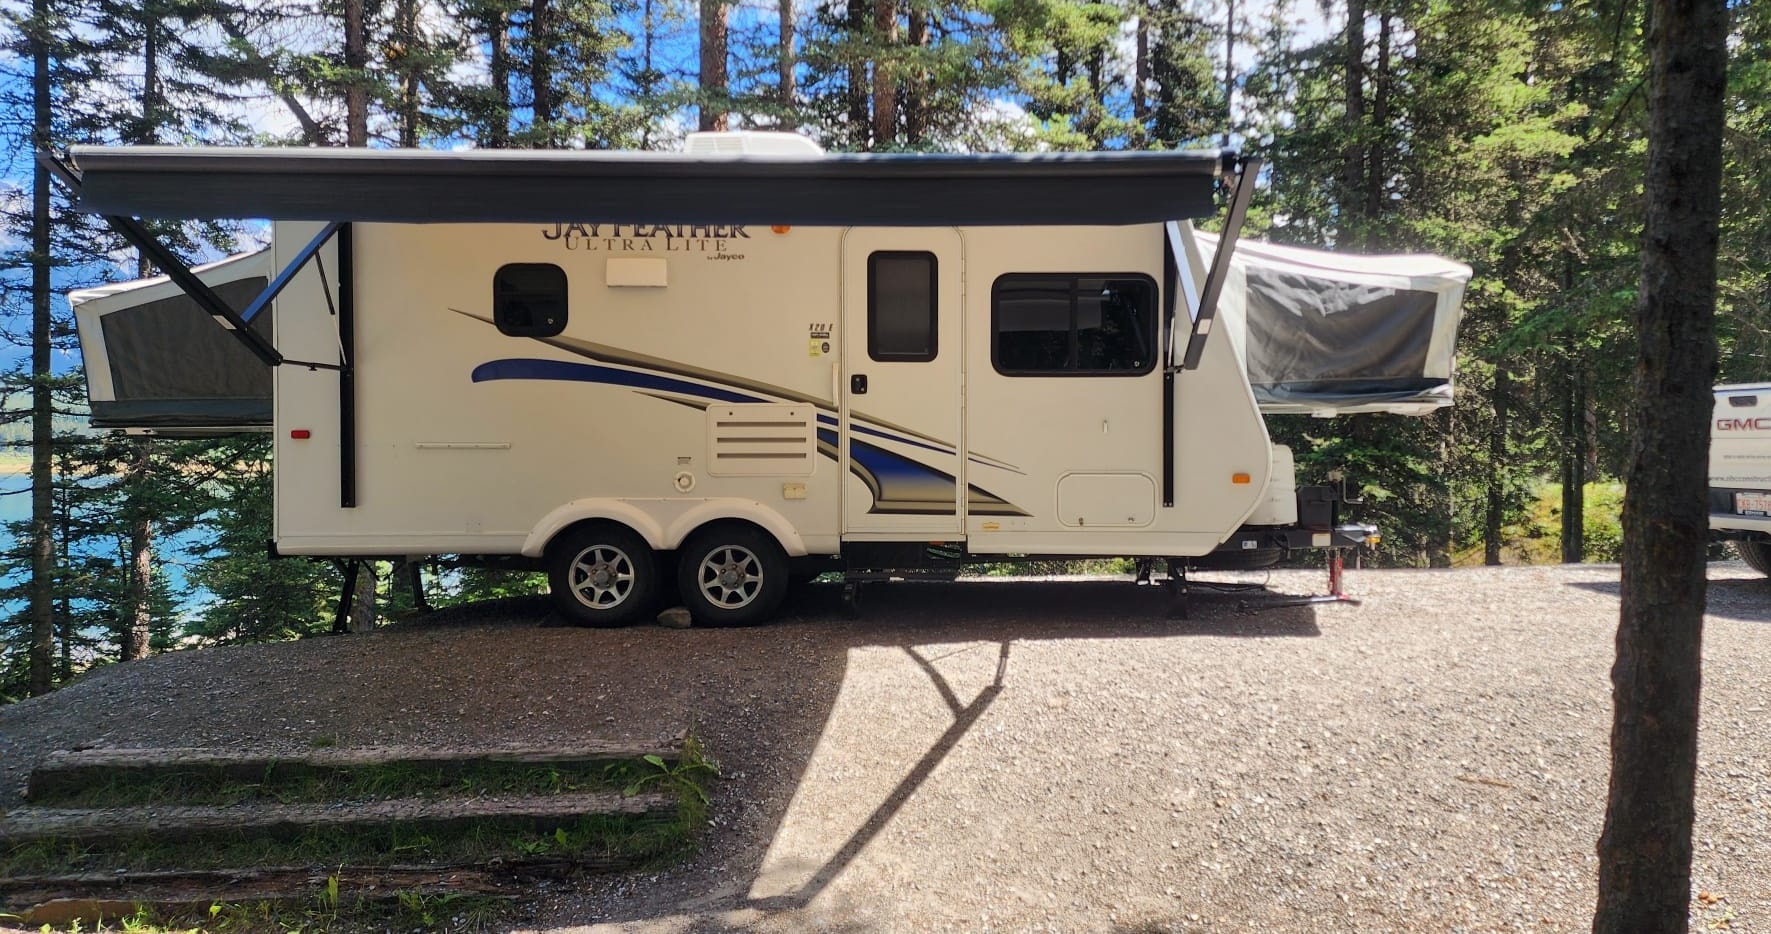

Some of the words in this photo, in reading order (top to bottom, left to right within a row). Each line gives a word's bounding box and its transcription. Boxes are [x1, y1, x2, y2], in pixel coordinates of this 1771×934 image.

[542, 223, 600, 240] JAY
[565, 236, 653, 251] ULTRA
[666, 236, 727, 251] LITE
[713, 252, 745, 262] Jayco
[1717, 418, 1771, 431] GMC
